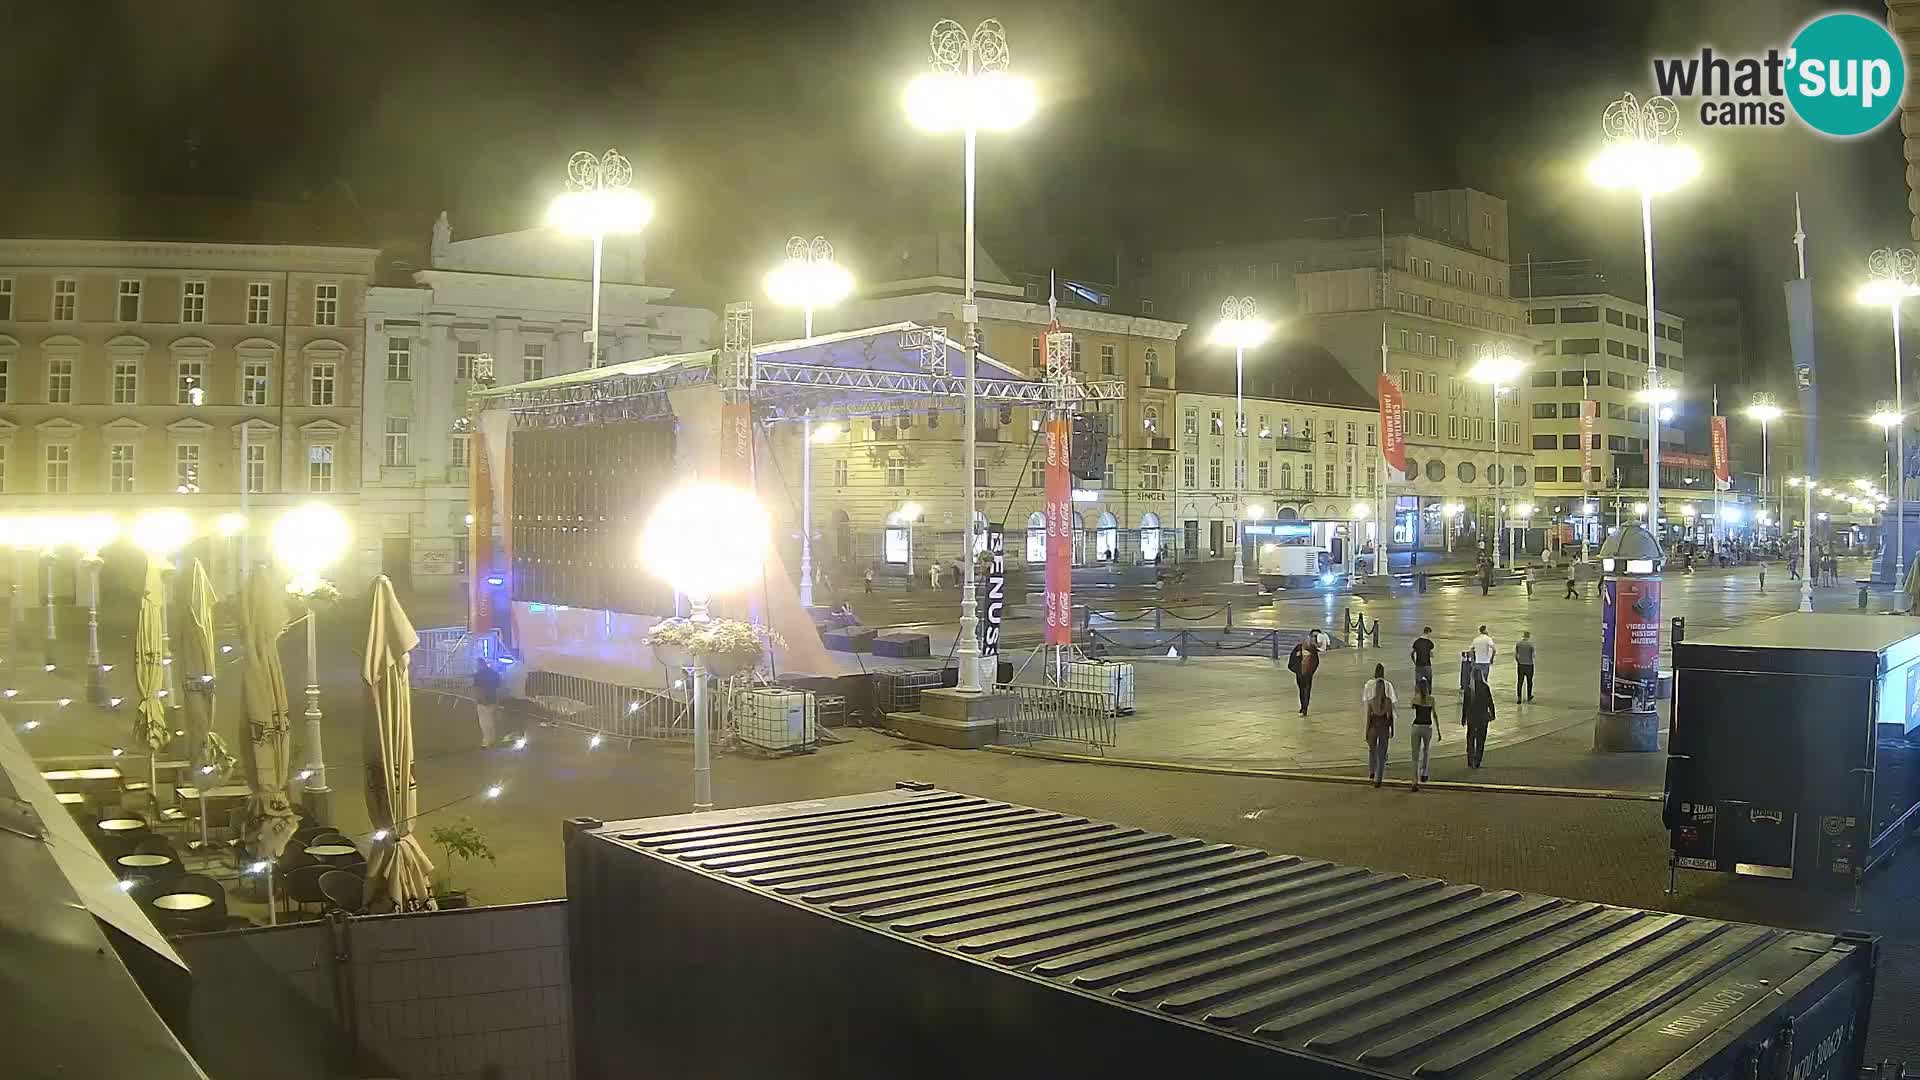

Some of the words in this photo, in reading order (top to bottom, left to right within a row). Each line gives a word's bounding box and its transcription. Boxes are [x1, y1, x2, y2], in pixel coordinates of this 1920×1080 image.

[1383, 394, 1391, 414] FANS
[1386, 415, 1395, 452] EMBASSY
[1392, 404, 1402, 443] CROATIAN
[1046, 432, 1056, 466] Coca-Cola
[960, 488, 995, 499] SGER
[1138, 492, 1165, 501] SINGER
[1047, 501, 1056, 537] Coca-Cola
[1060, 501, 1069, 537] Coca-Cola
[1047, 592, 1056, 627] Coca-Cola
[1060, 592, 1069, 627] Coca-Cola
